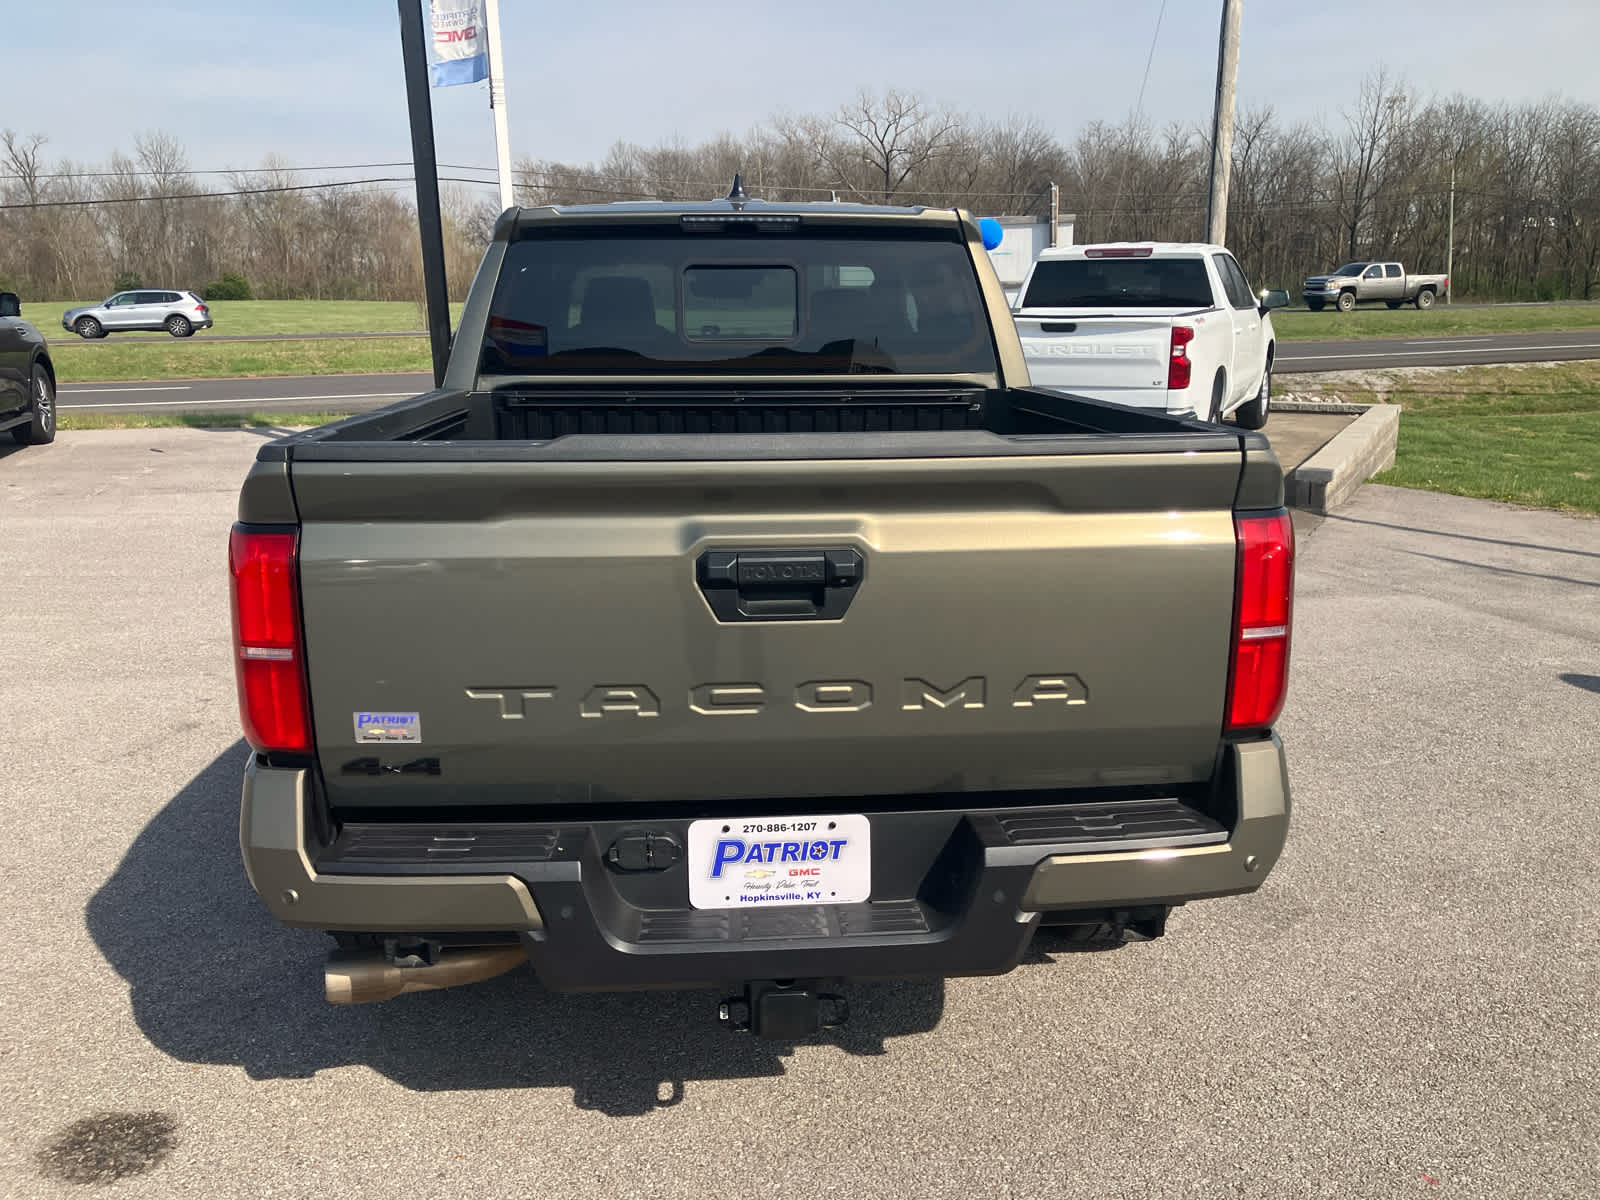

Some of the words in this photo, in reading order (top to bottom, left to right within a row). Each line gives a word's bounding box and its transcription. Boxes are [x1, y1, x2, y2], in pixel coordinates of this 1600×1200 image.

[1023, 343, 1154, 356] VROLET
[743, 565, 824, 580] TOYOTA
[465, 673, 1090, 719] TACOMA
[358, 713, 416, 728] PATRIOT
[743, 822, 817, 833] 270-886-1207
[709, 839, 847, 878] PATRIOT
[788, 868, 821, 877] GMC
[740, 893, 804, 903] Hopkinsville,
[807, 891, 821, 899] KY
